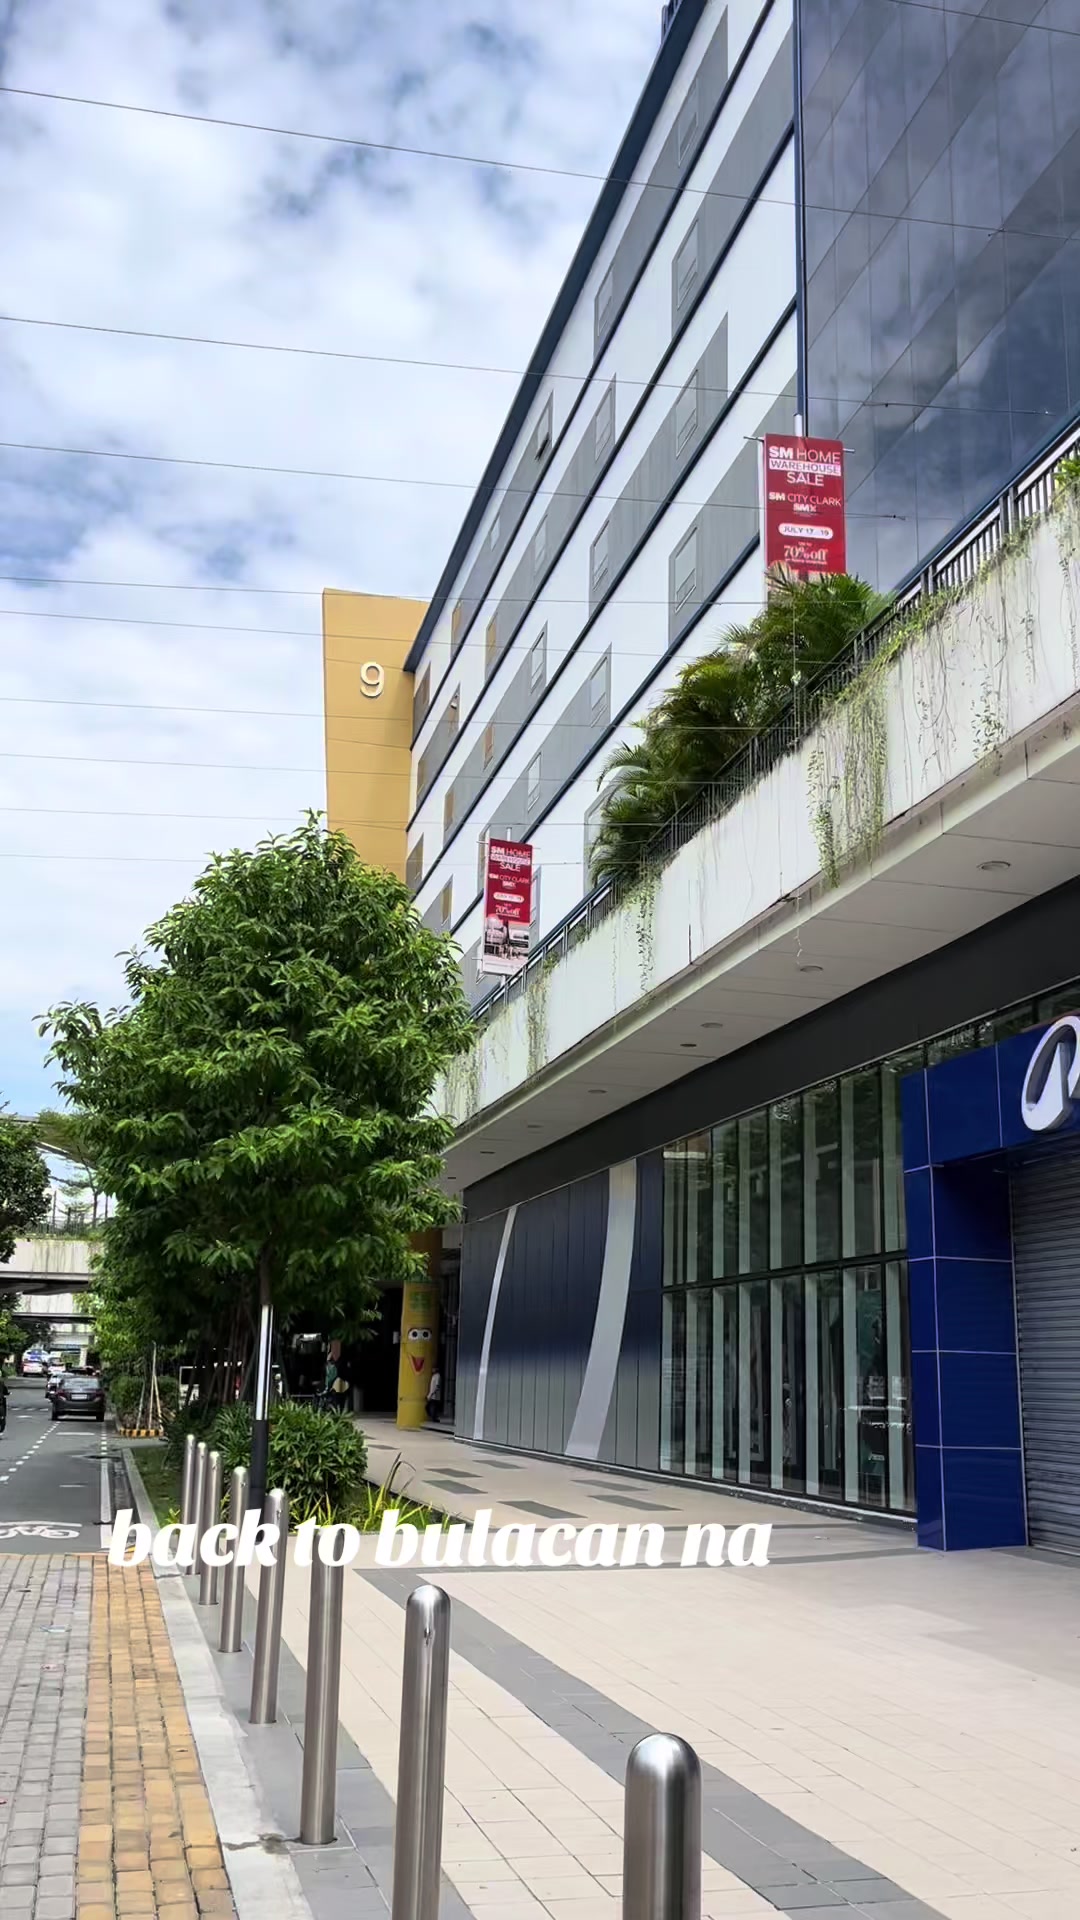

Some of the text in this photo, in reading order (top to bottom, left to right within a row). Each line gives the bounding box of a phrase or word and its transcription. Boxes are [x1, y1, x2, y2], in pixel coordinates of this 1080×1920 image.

[769, 446, 841, 464] SM HOME
[771, 460, 840, 474] WAREHOUSE
[787, 472, 824, 487] SALE
[769, 492, 842, 507] SM CITY CLARK
[793, 503, 817, 512] SMX
[360, 661, 384, 697] 9
[491, 846, 530, 858] SM HOME
[500, 861, 520, 872] SALE
